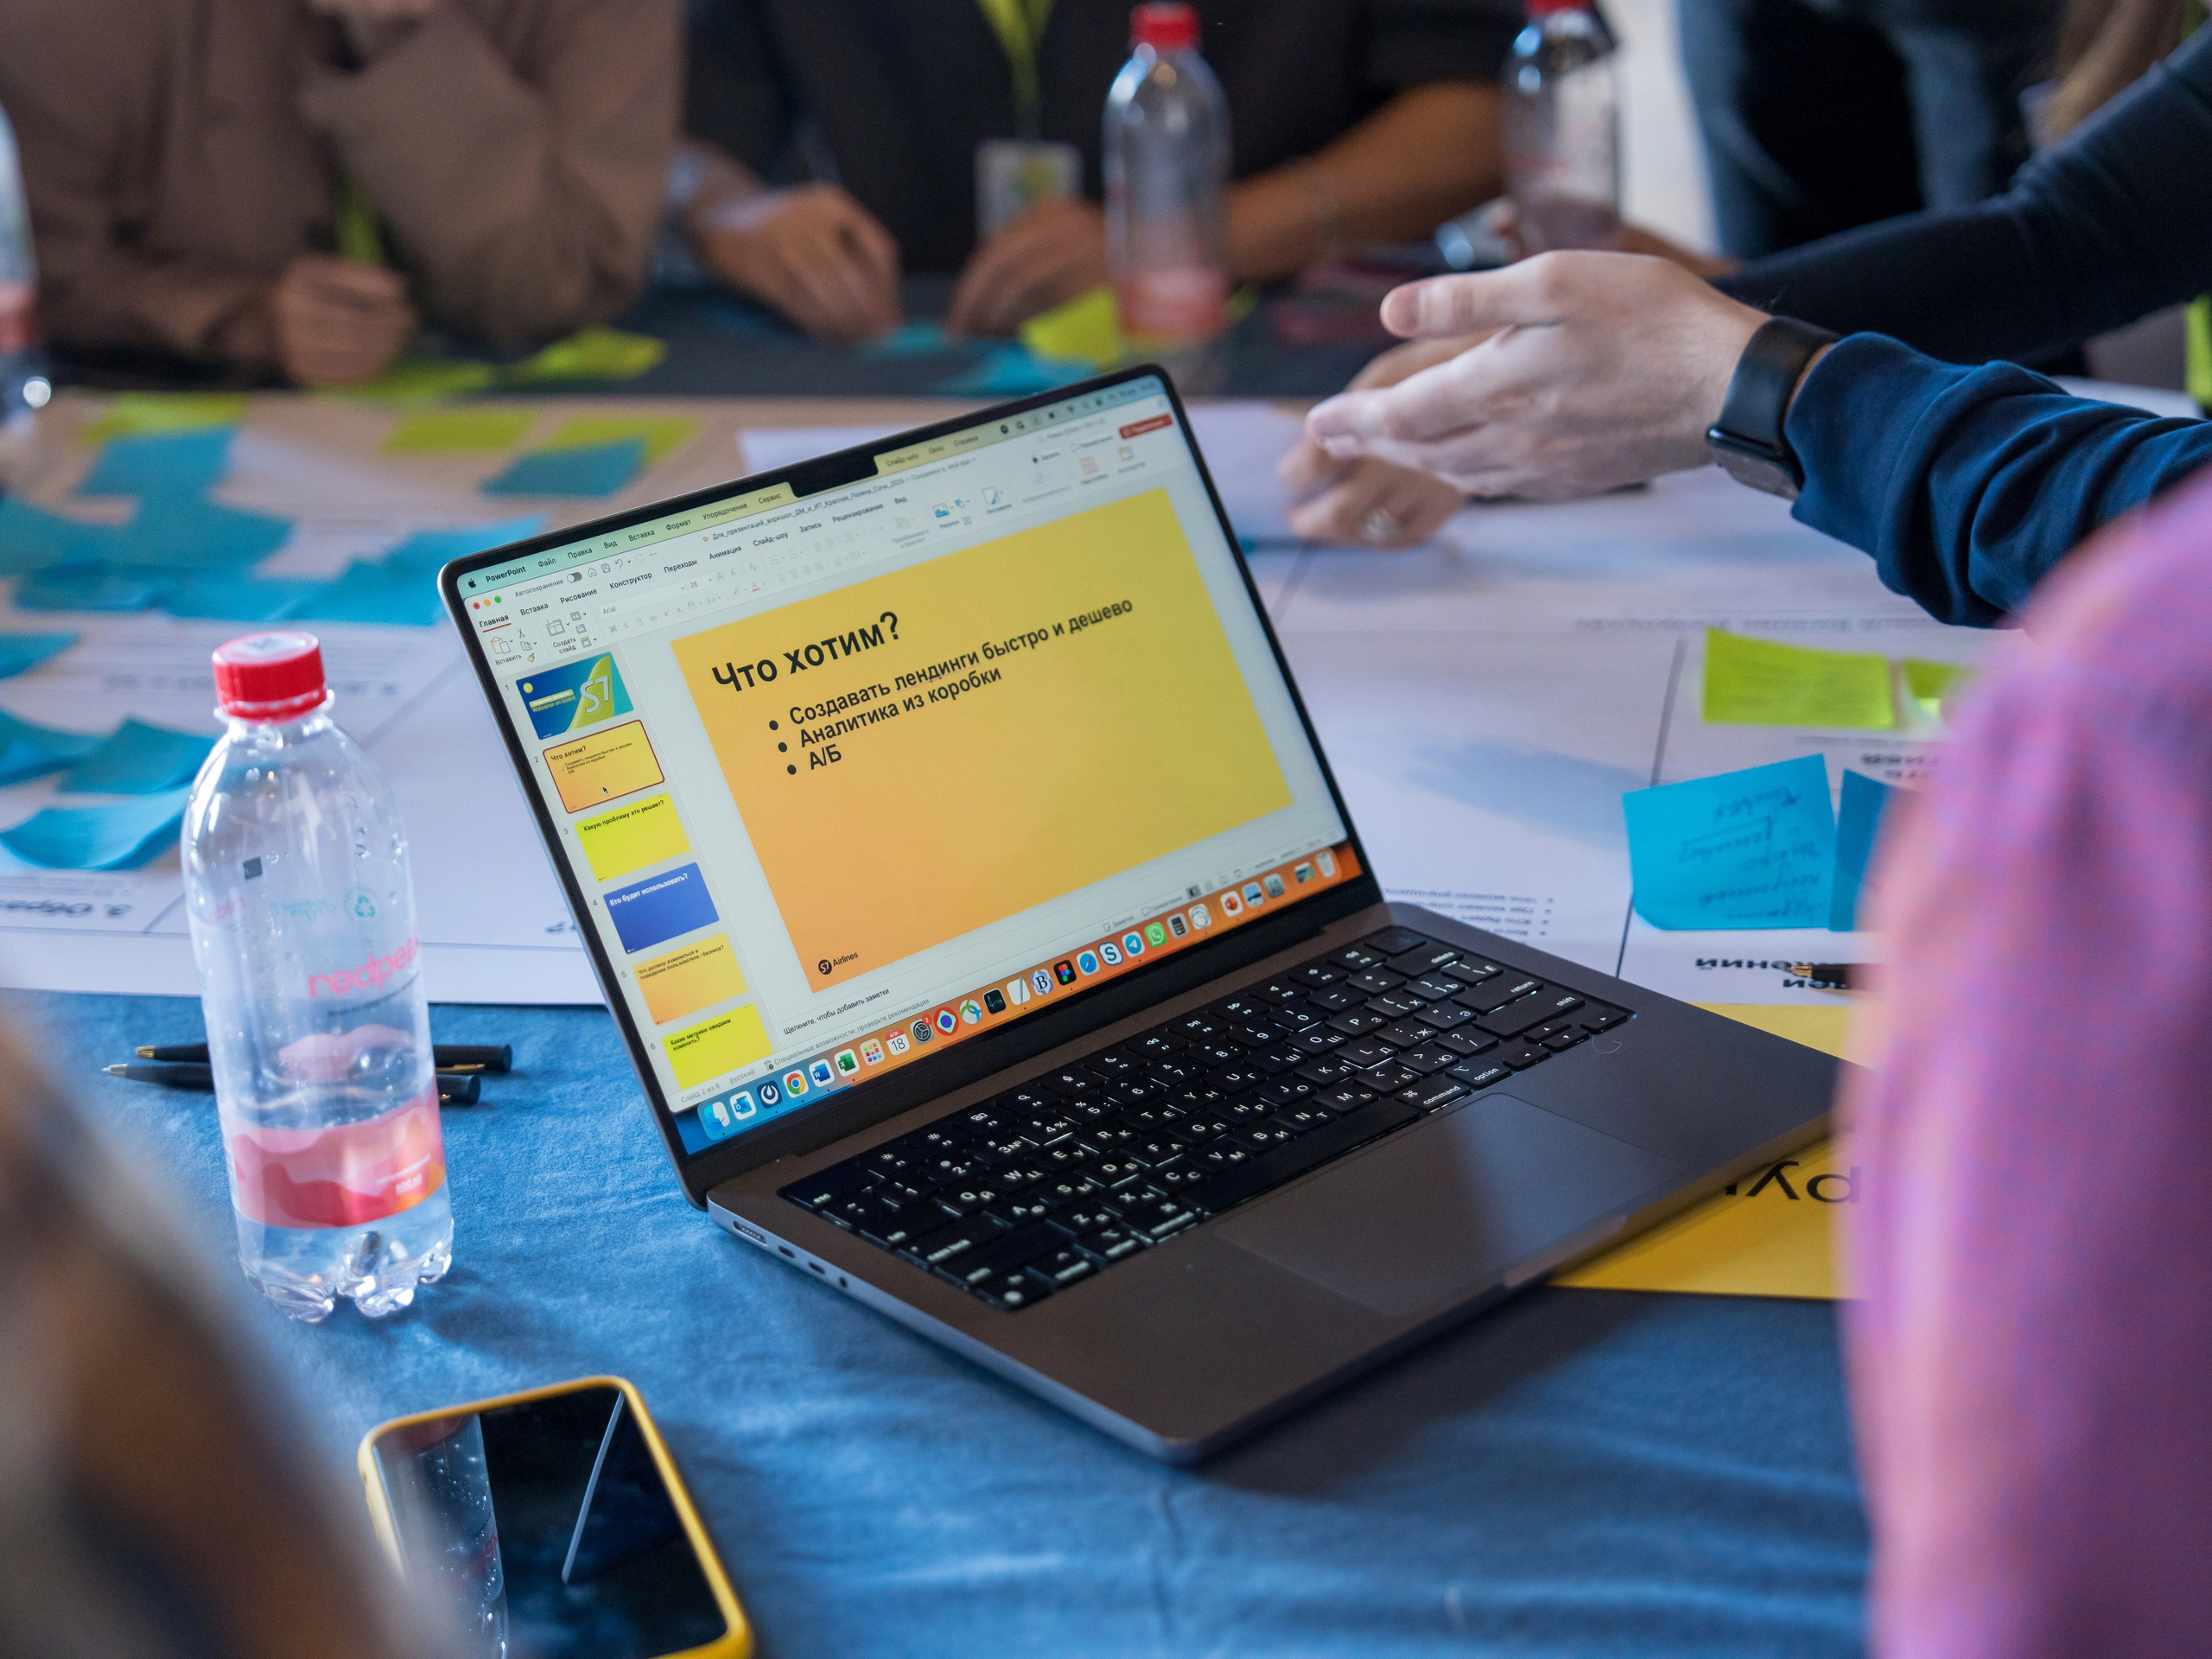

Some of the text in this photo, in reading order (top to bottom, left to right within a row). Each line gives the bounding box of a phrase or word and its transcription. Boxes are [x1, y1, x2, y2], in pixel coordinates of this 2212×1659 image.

[758, 493, 782, 504] Сервис
[702, 503, 747, 520] Упорядочение
[832, 504, 883, 523] Рецензирование
[666, 519, 691, 531] Формат
[799, 523, 823, 533] Запись
[628, 529, 655, 542] Вставка
[753, 531, 788, 546] Слайд-шоу
[603, 540, 618, 550] Вид
[567, 548, 593, 559] Правка
[709, 546, 741, 559] Анимация
[537, 557, 556, 568] Файл
[664, 559, 697, 573] Переходы
[486, 566, 526, 582] PowerPoint
[609, 572, 652, 589] Конструктор
[515, 579, 563, 597] Автосохранение
[560, 588, 598, 603] Рисование
[520, 603, 549, 615] Вставка
[603, 606, 617, 614] Arial
[479, 613, 509, 628] Главная
[553, 638, 576, 648] Создать
[559, 645, 577, 654] слайд
[711, 611, 901, 692] Что хотим?
[495, 654, 522, 665] Вставить
[789, 599, 1133, 727] Создавать лендинги быстро и дешево
[580, 676, 609, 714] S7
[531, 702, 555, 713] Welcome
[799, 664, 1002, 748] Аналитика из коробки
[550, 746, 587, 761] Что хотим?
[809, 742, 842, 771] А/Б
[583, 822, 602, 832] Какую
[602, 812, 630, 825] проблему
[641, 799, 664, 812] решает?
[609, 873, 688, 906] Кто будет использовать?
[833, 952, 859, 967] Airlines
[1104, 946, 1117, 962] S
[1035, 975, 1048, 990] B
[1510, 980, 1535, 994] return
[1556, 995, 1575, 1007] shift
[783, 988, 890, 1035] Щелкните, чтобы добавить заметки
[773, 998, 930, 1065] Специальные возможности: проверьте рекомендации
[671, 1037, 686, 1046] Какие
[672, 1037, 701, 1052] изменить?
[891, 1038, 906, 1052] 18
[1286, 1053, 1300, 1062] Ш
[729, 1069, 755, 1084] русский
[1473, 1067, 1499, 1081] option
[680, 1092, 701, 1103] Слайд
[1423, 1084, 1460, 1105] command
[1295, 1112, 1311, 1121] N
[1046, 1125, 1056, 1134] 4
[998, 1145, 1011, 1154] 3
[1004, 1170, 1023, 1180] W
[1102, 1164, 1117, 1173] D
[1057, 1185, 1072, 1193] S
[1726, 1160, 1862, 1204] ру
